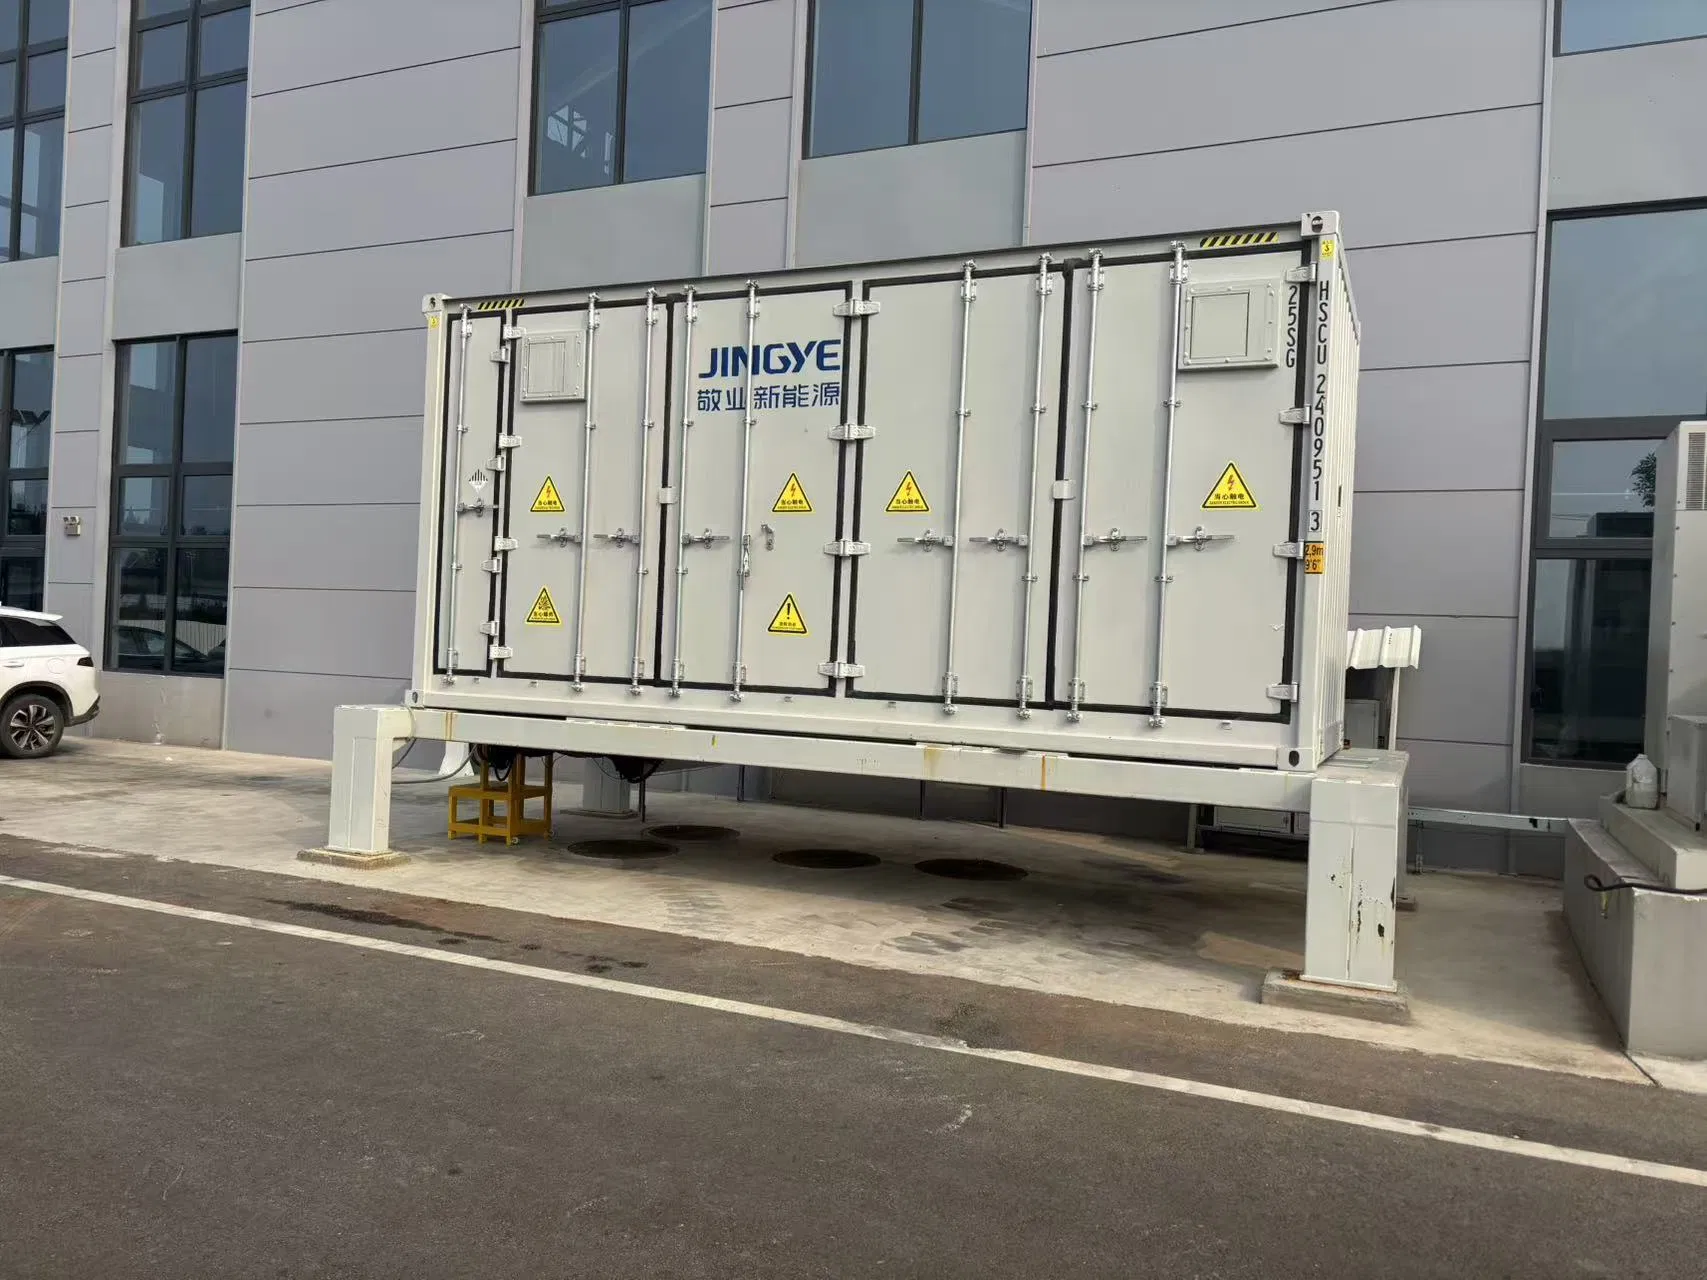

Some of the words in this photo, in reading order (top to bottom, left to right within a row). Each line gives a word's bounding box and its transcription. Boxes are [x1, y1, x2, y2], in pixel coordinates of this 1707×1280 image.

[698, 338, 842, 379] JINGYE
[1285, 285, 1299, 368] 25SG
[1316, 280, 1329, 365] HSCU
[696, 381, 841, 412] 敬业新能源
[1312, 373, 1327, 501] 240951
